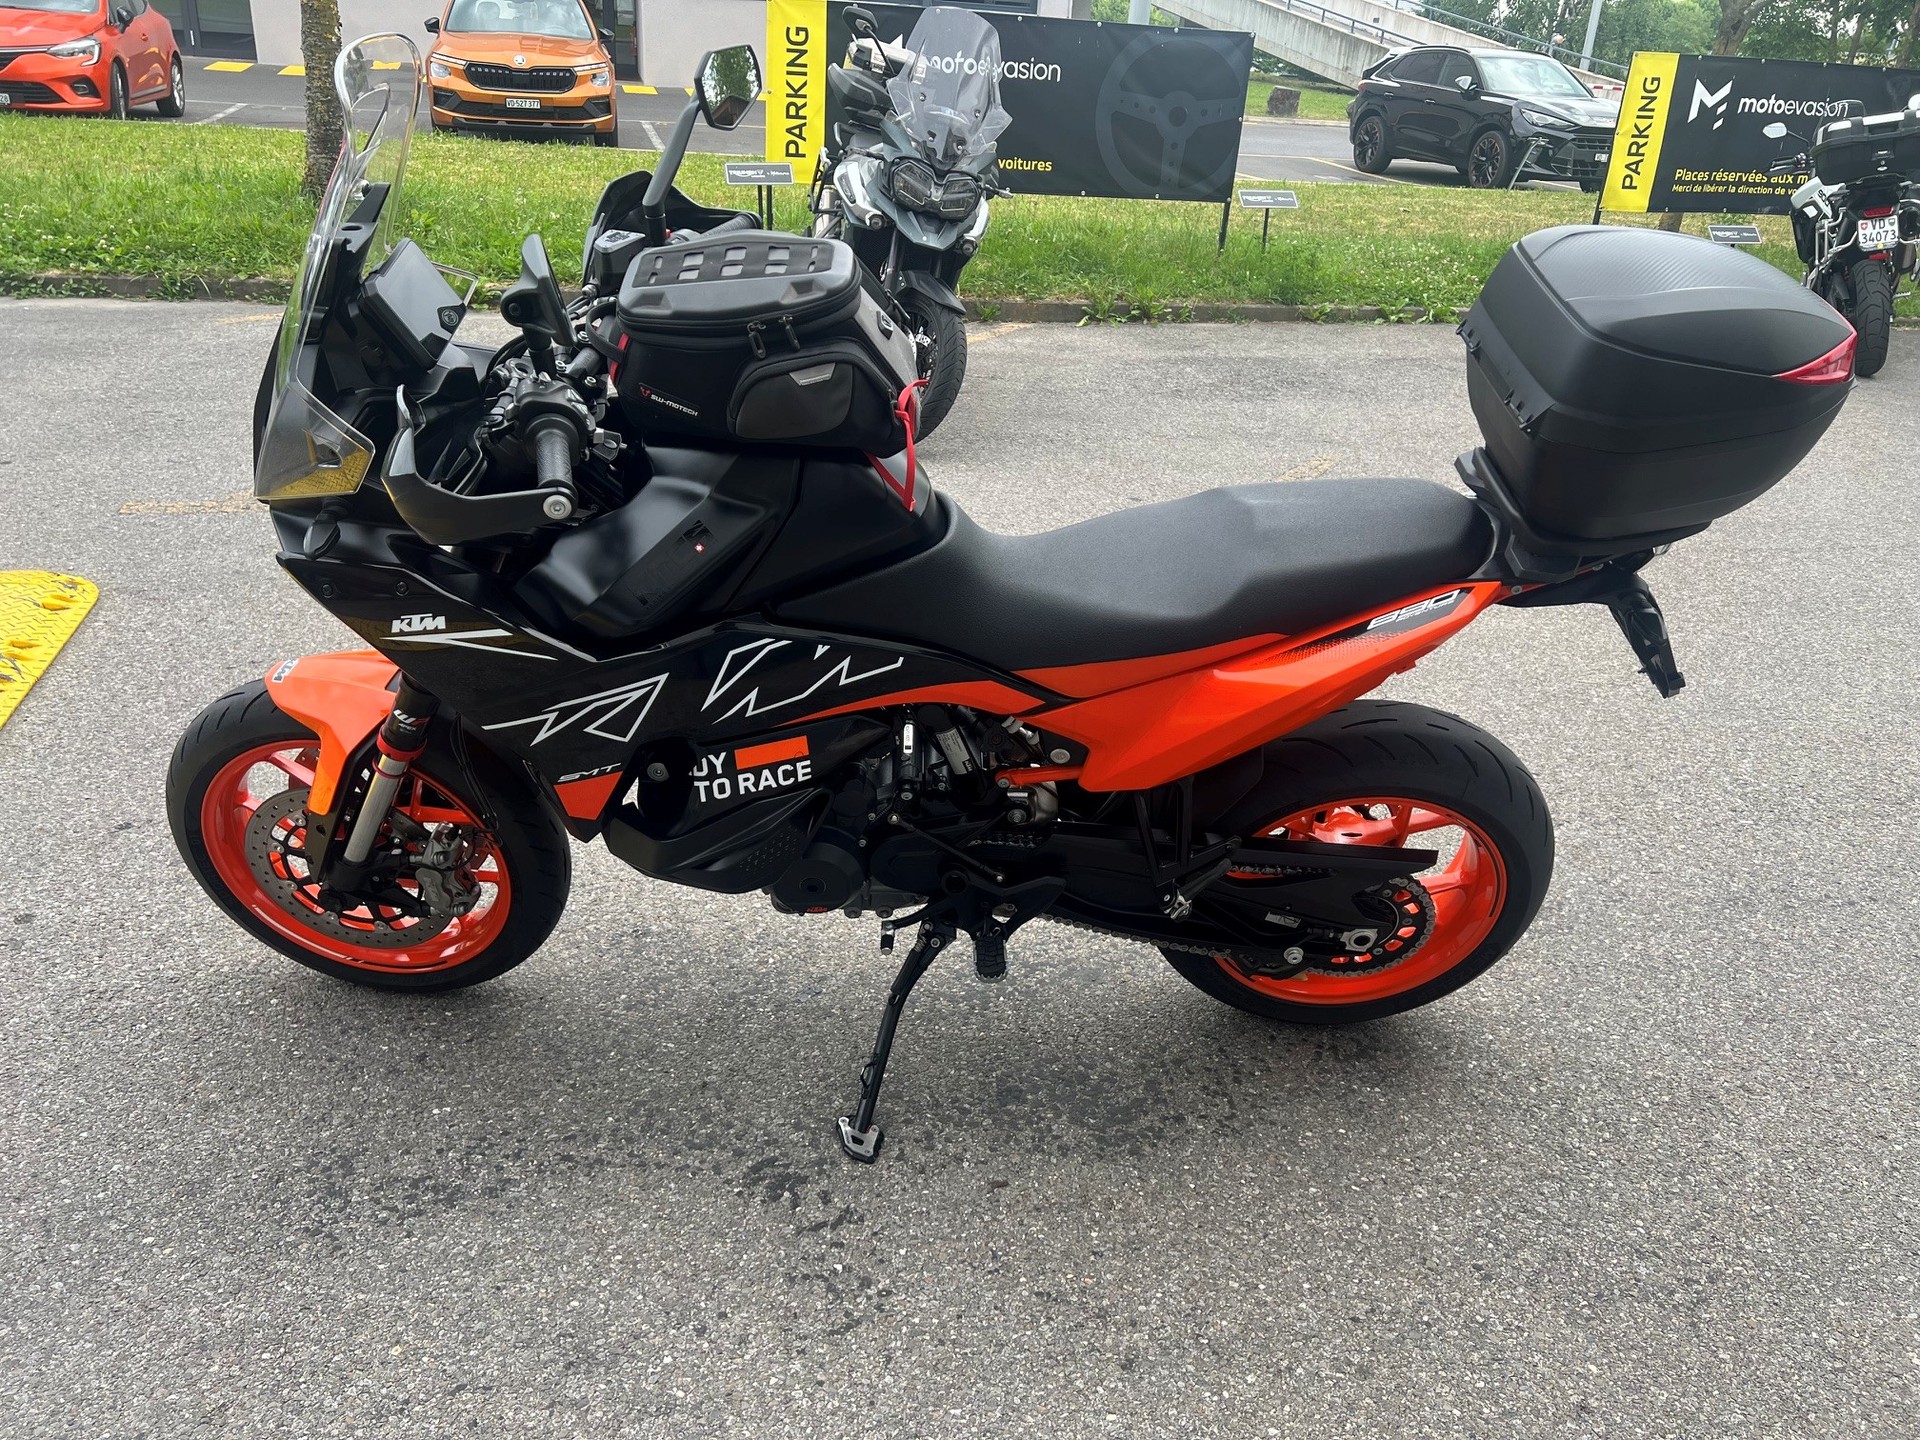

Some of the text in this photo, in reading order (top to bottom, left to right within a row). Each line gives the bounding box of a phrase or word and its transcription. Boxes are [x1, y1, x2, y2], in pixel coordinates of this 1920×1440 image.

[785, 26, 809, 158] PARKING
[1737, 94, 1849, 117] motoevasion
[1621, 77, 1661, 190] PARKING
[998, 157, 1052, 172] voitures
[1674, 168, 1709, 181] Places
[1672, 183, 1692, 192] Merci
[1692, 184, 1702, 192] de
[1728, 184, 1736, 193] la
[1737, 185, 1773, 195] direction
[1774, 186, 1785, 195] de
[1871, 218, 1886, 230] VD
[1861, 229, 1897, 244] 34073
[1366, 589, 1461, 630] 890
[391, 613, 446, 634] KTM
[557, 762, 622, 783] SMT
[694, 760, 812, 803] TO RACE
